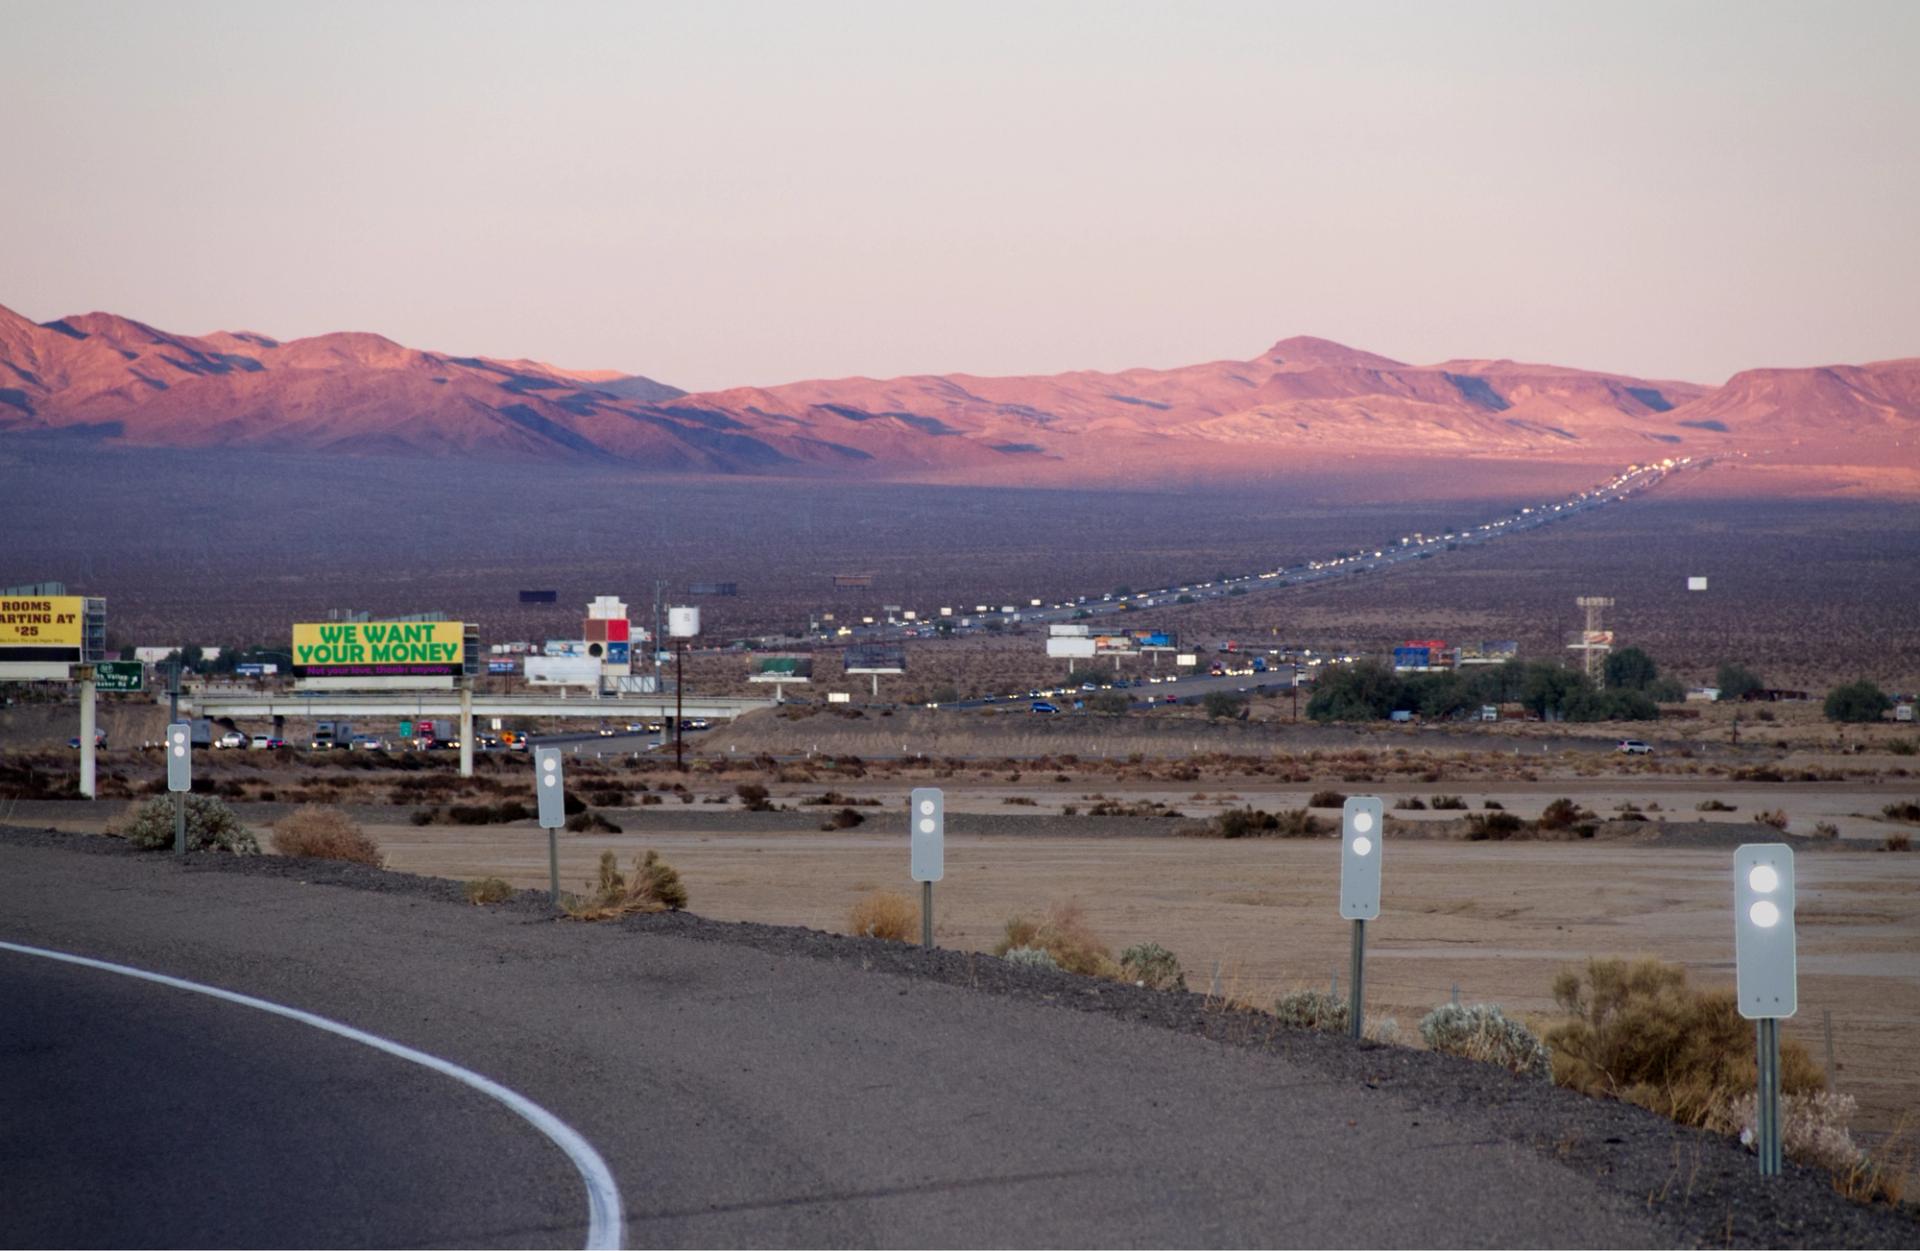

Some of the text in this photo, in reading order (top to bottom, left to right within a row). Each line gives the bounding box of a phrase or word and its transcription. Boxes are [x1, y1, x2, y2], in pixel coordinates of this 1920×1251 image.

[2, 601, 51, 611] ROOMS
[0, 613, 76, 624] ARTING AT
[15, 626, 39, 636] $25
[320, 624, 435, 644] WE WANT
[297, 643, 458, 663] YOUR MONEY
[107, 673, 128, 682] Valley
